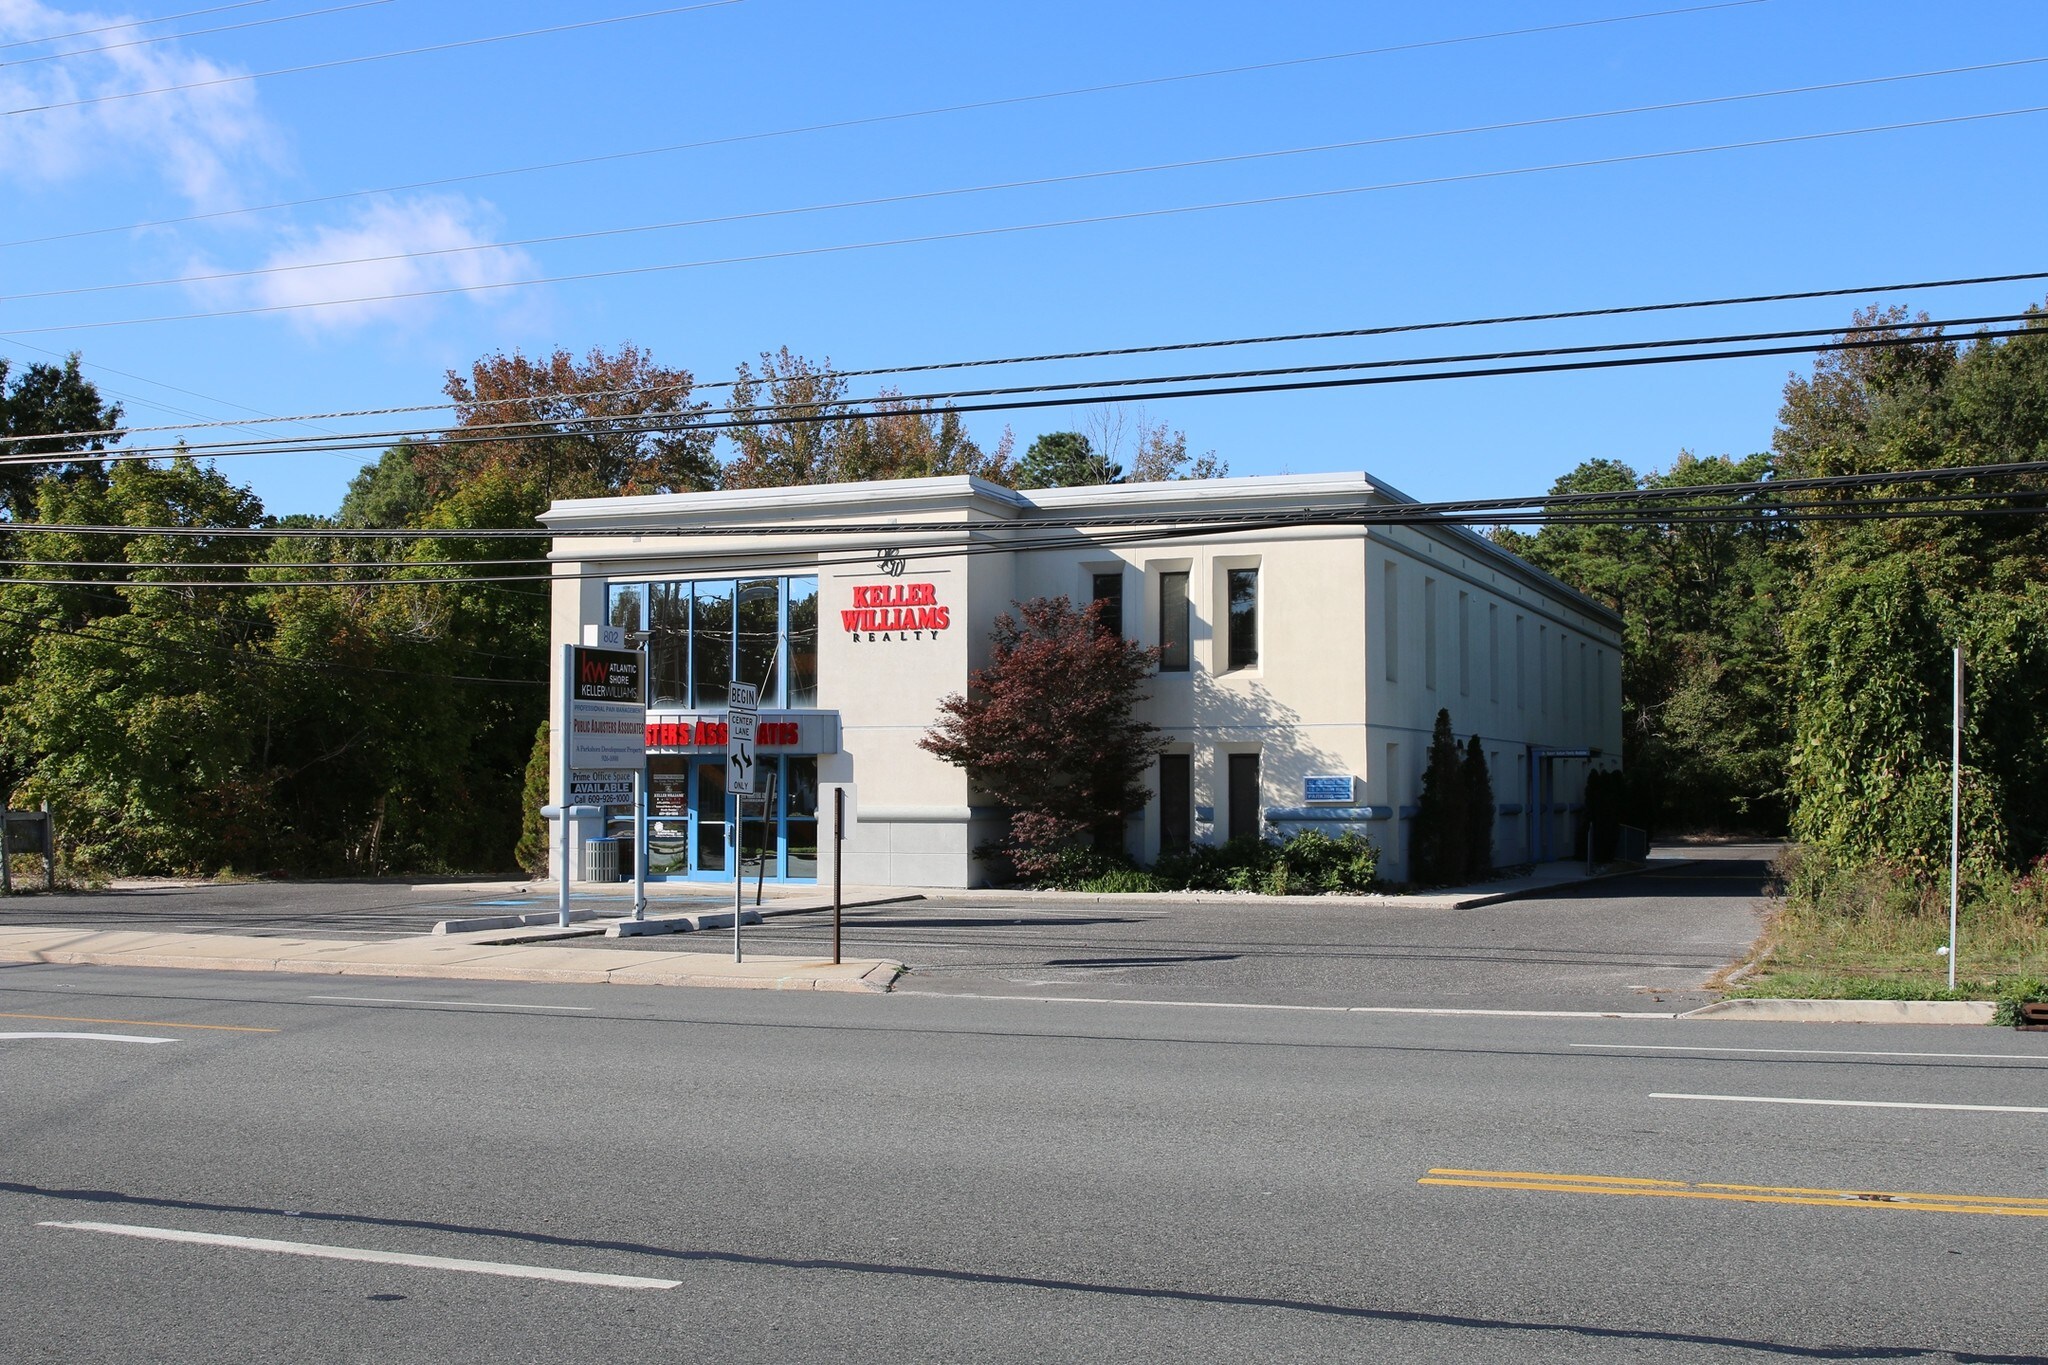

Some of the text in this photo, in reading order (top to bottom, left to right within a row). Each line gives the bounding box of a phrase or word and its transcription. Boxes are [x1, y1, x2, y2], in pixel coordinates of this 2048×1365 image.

[853, 583, 937, 608] KELLER
[841, 606, 951, 632] WILLIAMS
[603, 630, 619, 644] 802
[852, 631, 939, 643] REALTY
[609, 663, 637, 674] ATLANTIC
[609, 675, 629, 685] SHORE
[731, 687, 755, 705] BEGIN
[574, 704, 605, 713] PROFESSIONAL
[616, 706, 643, 714] MANAGEMENT
[731, 715, 753, 726] CENTER
[646, 721, 799, 747] STERS ASSATES
[735, 726, 750, 736] LANE
[573, 771, 631, 782] Prime Office Space
[574, 783, 629, 793] AVAILABLE
[734, 781, 749, 790] ONLY
[574, 793, 630, 804] Call 609-926-1000
